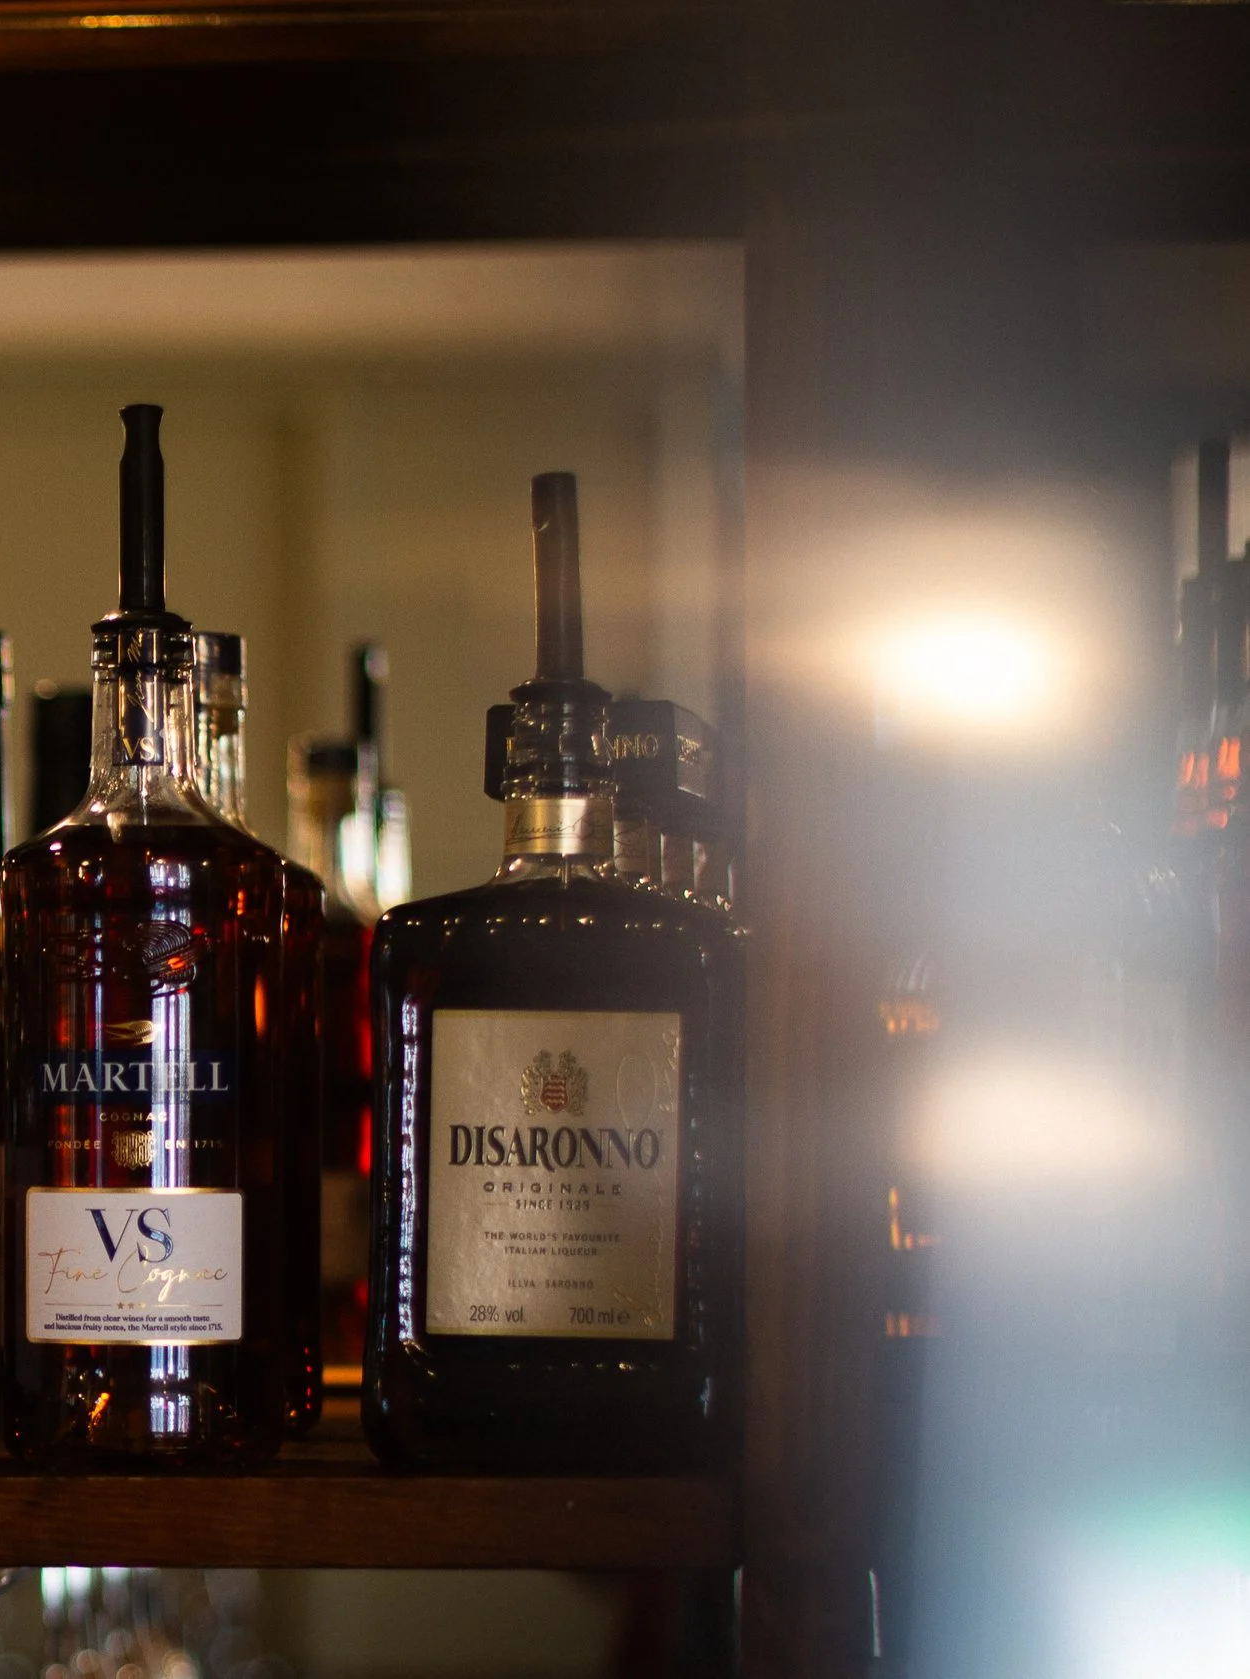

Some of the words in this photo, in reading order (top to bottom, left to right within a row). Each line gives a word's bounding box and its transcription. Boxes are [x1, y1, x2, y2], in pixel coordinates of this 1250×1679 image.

[41, 1062, 229, 1092] MARTELL
[99, 1112, 167, 1121] COGNAC
[449, 1124, 659, 1172] DISARONNO
[483, 1182, 622, 1196] ORIGINALE
[515, 1199, 552, 1210] SINCE
[85, 1207, 174, 1262] VS
[484, 1231, 504, 1240] THE
[38, 1247, 108, 1294] Fine
[56, 1313, 83, 1321] Distilled
[469, 1305, 499, 1322] 28%
[569, 1306, 594, 1324] 700
[598, 1306, 615, 1324] ml
[83, 1322, 102, 1332] fruity
[170, 1323, 188, 1332] style
[189, 1323, 207, 1331] since
